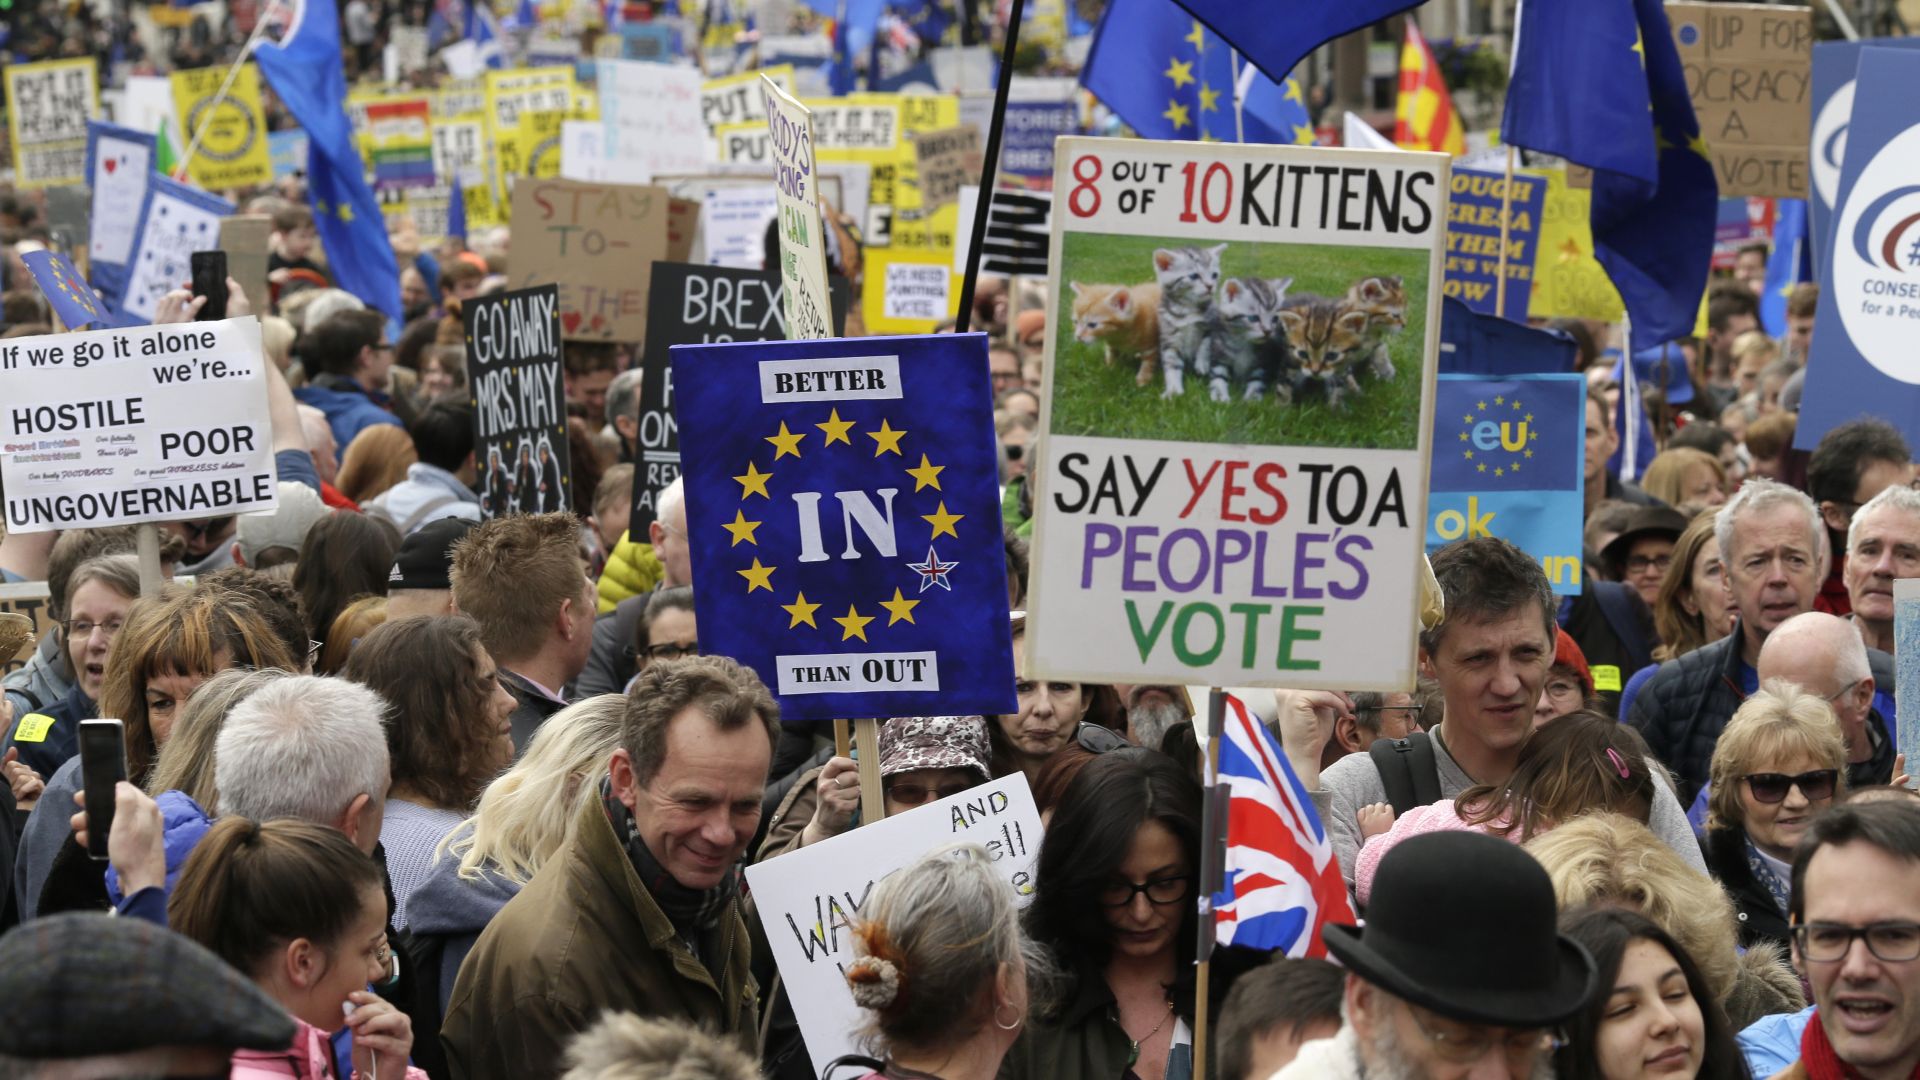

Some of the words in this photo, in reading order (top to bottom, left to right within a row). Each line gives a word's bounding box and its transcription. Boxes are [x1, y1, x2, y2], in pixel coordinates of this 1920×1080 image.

[1711, 16, 1744, 50] UP
[1684, 63, 1810, 103] OCRACY
[1721, 109, 1748, 139] A
[730, 136, 769, 160] PU
[1002, 149, 1054, 169] BREX
[1068, 154, 1103, 218] 8
[1112, 161, 1172, 183] OUT
[1452, 174, 1533, 202] OUGH
[1718, 155, 1804, 191] VOTE
[532, 183, 650, 226] STAY
[1118, 189, 1156, 214] OF
[1179, 161, 1233, 223] 10
[1240, 163, 1435, 234] KITTENS
[1448, 202, 1531, 232] ERESA
[1446, 231, 1525, 260] YHEM
[683, 275, 800, 334] BREX
[1443, 279, 1492, 302] OW
[1862, 279, 1920, 299] CONSE
[1861, 300, 1882, 314] for
[1886, 306, 1895, 316] a
[3, 346, 19, 369] If
[27, 347, 63, 366] we
[73, 341, 104, 367] go
[112, 335, 131, 358] it
[141, 331, 216, 356] alone
[473, 304, 506, 363] GO
[153, 358, 251, 384] we're...
[775, 368, 886, 394] BETTER
[519, 361, 558, 429] MAY
[12, 397, 145, 435] HOSTILE
[160, 426, 254, 460] POOR
[1472, 420, 1528, 452] eu
[9, 474, 272, 526] UNGOVERNABLE
[1054, 452, 1169, 517] SAY
[1178, 458, 1288, 525] YES
[1299, 464, 1368, 526] TO
[1368, 467, 1409, 528] A
[791, 488, 899, 562] IN
[1435, 496, 1496, 540] ok
[1080, 522, 1374, 600] PEOPLE'S
[1124, 599, 1325, 671] VOTE
[792, 665, 850, 684] THAN
[861, 658, 927, 683] OUT
[951, 790, 1008, 833] AND
[983, 820, 1026, 862] ell
